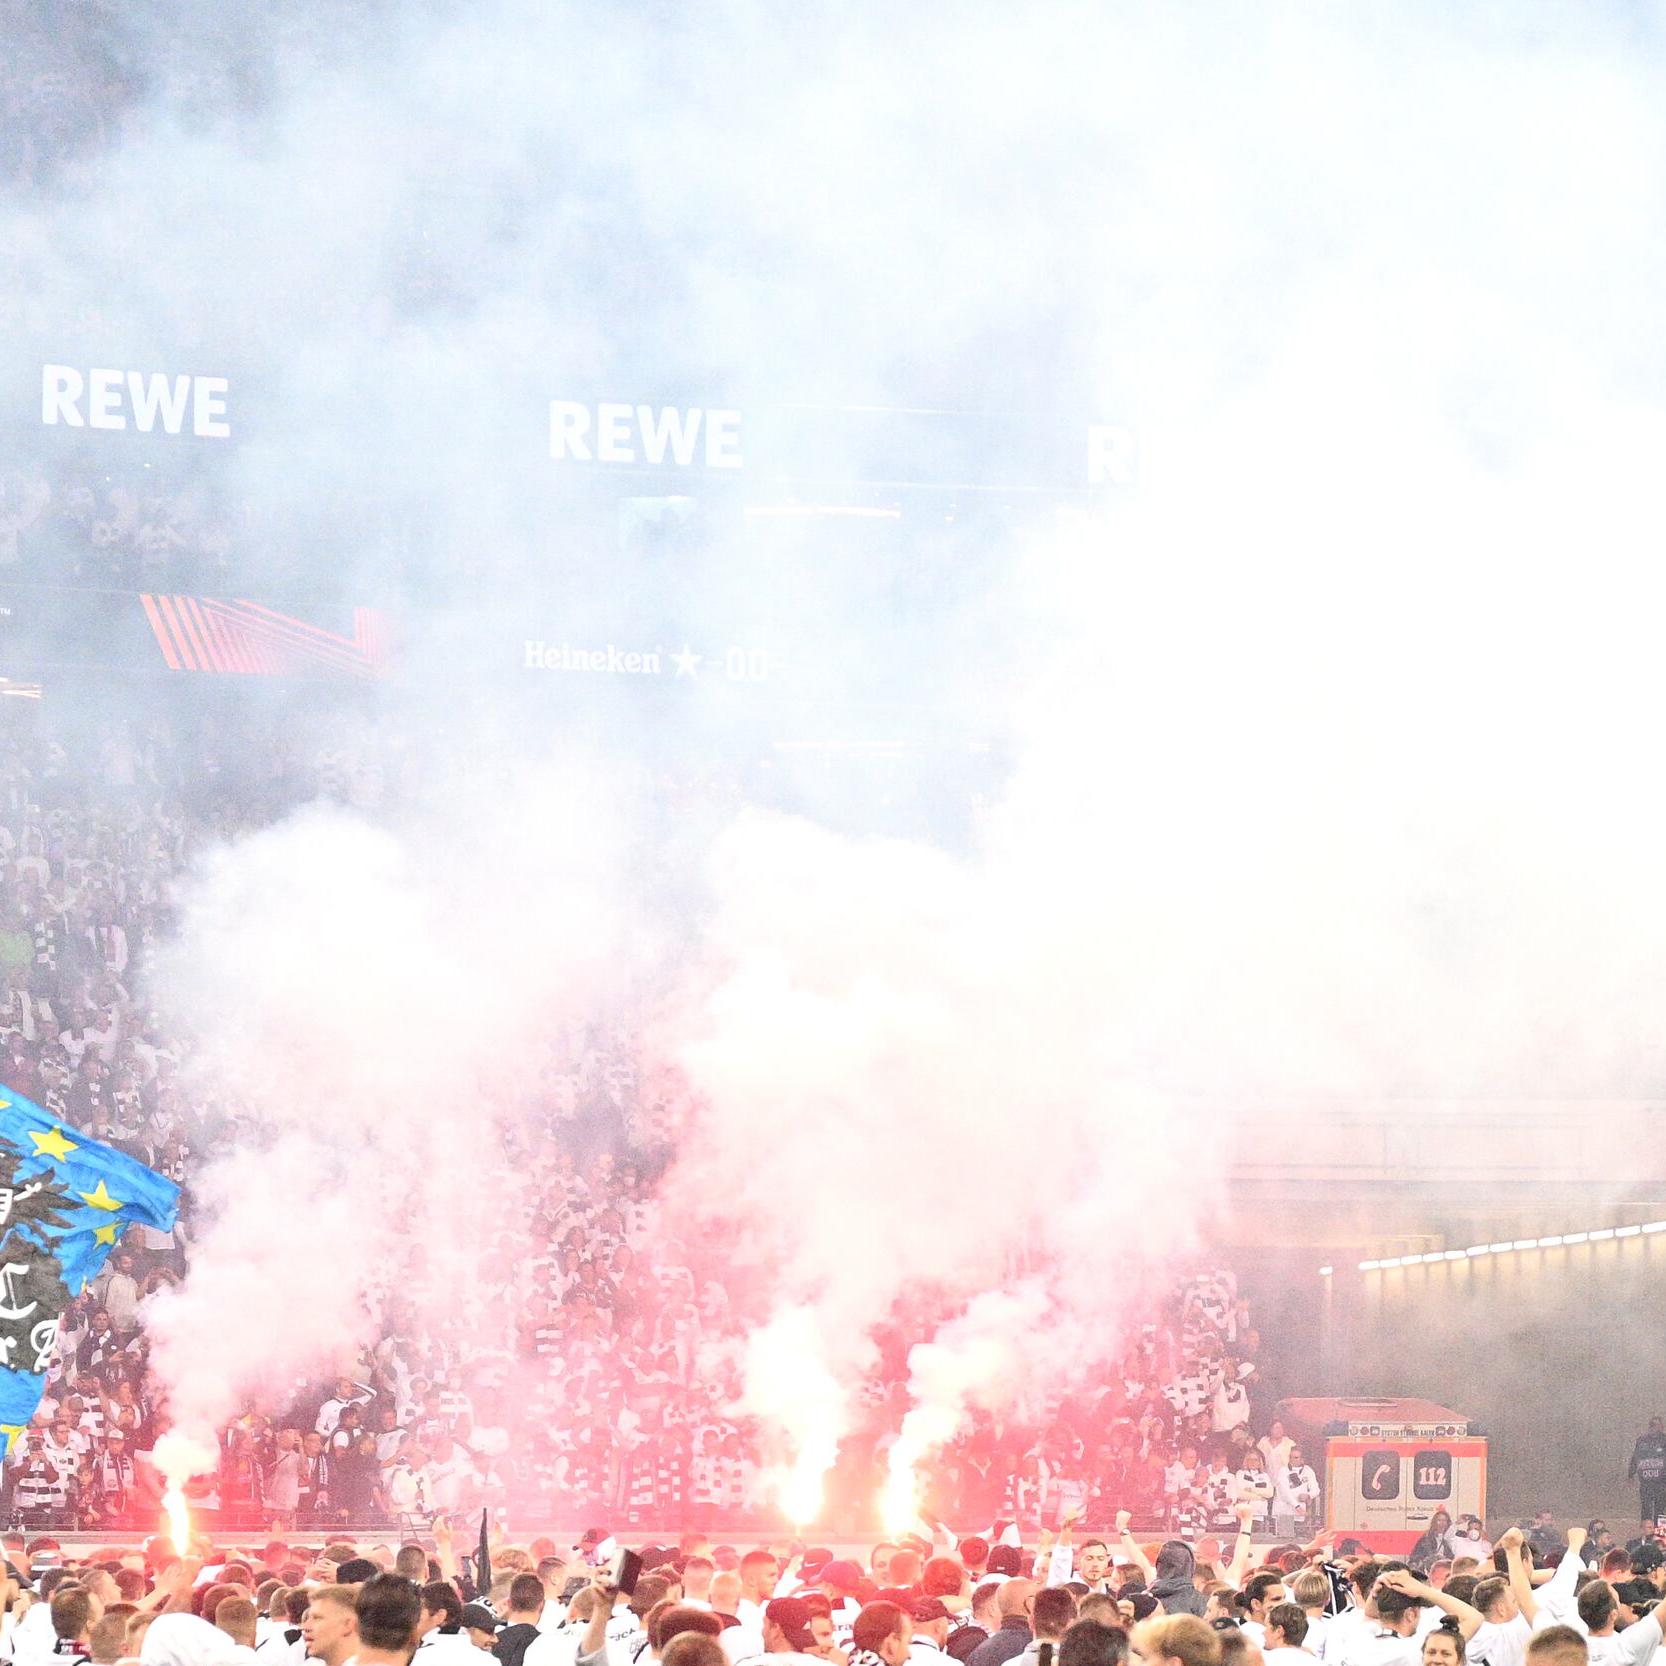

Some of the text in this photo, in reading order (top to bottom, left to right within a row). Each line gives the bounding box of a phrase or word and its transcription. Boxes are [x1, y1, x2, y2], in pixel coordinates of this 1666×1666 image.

[41, 364, 231, 437] REWE
[549, 400, 743, 468] REWE
[523, 640, 663, 675] Heineken
[1419, 1467, 1447, 1486] 112
